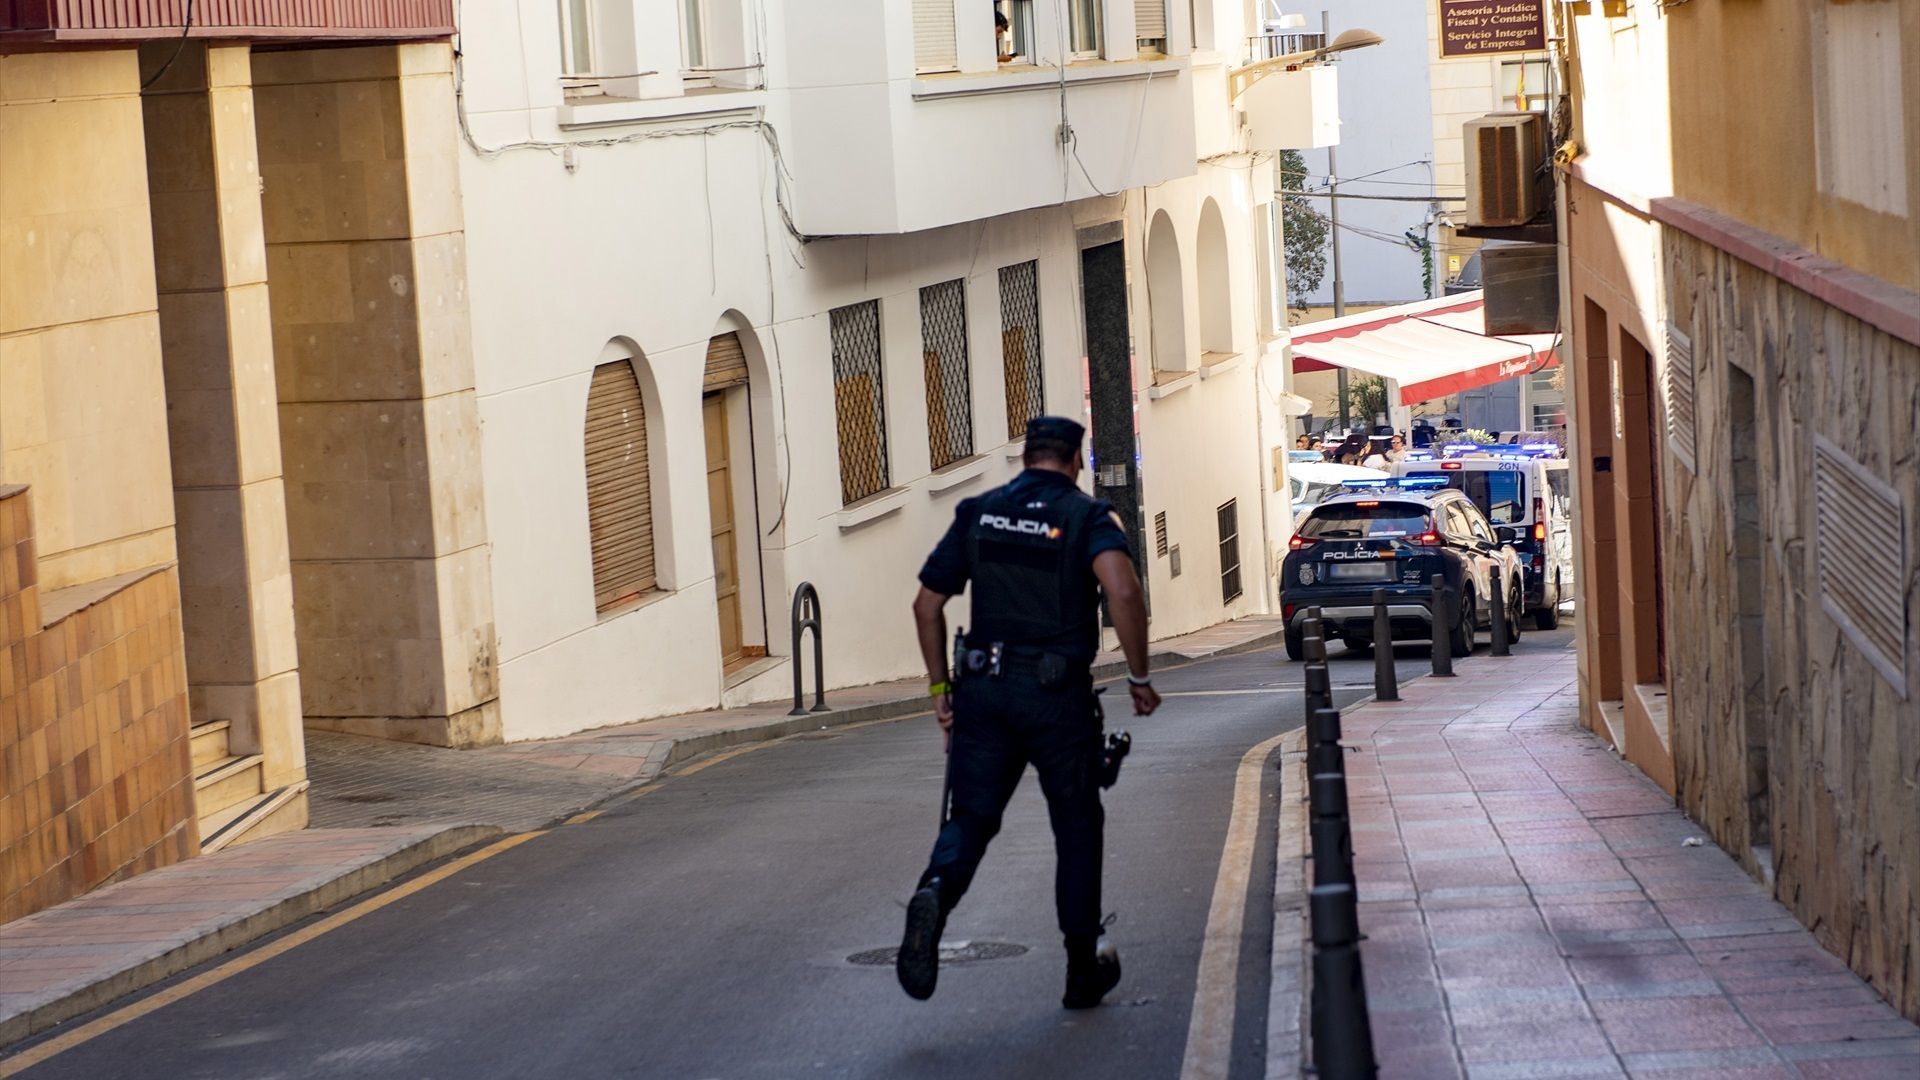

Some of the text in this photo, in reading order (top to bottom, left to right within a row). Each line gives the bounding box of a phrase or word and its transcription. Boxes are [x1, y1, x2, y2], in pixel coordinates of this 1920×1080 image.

[1447, 3, 1537, 16] Asesoría Jurídica
[1447, 14, 1538, 26] Fiscal y Contable
[1447, 27, 1538, 41] Servicio Integral
[1464, 39, 1526, 50] de Empresa
[1498, 462, 1520, 470] 2GN
[979, 513, 1051, 536] POLICIA
[1322, 550, 1381, 560] POLICIA
